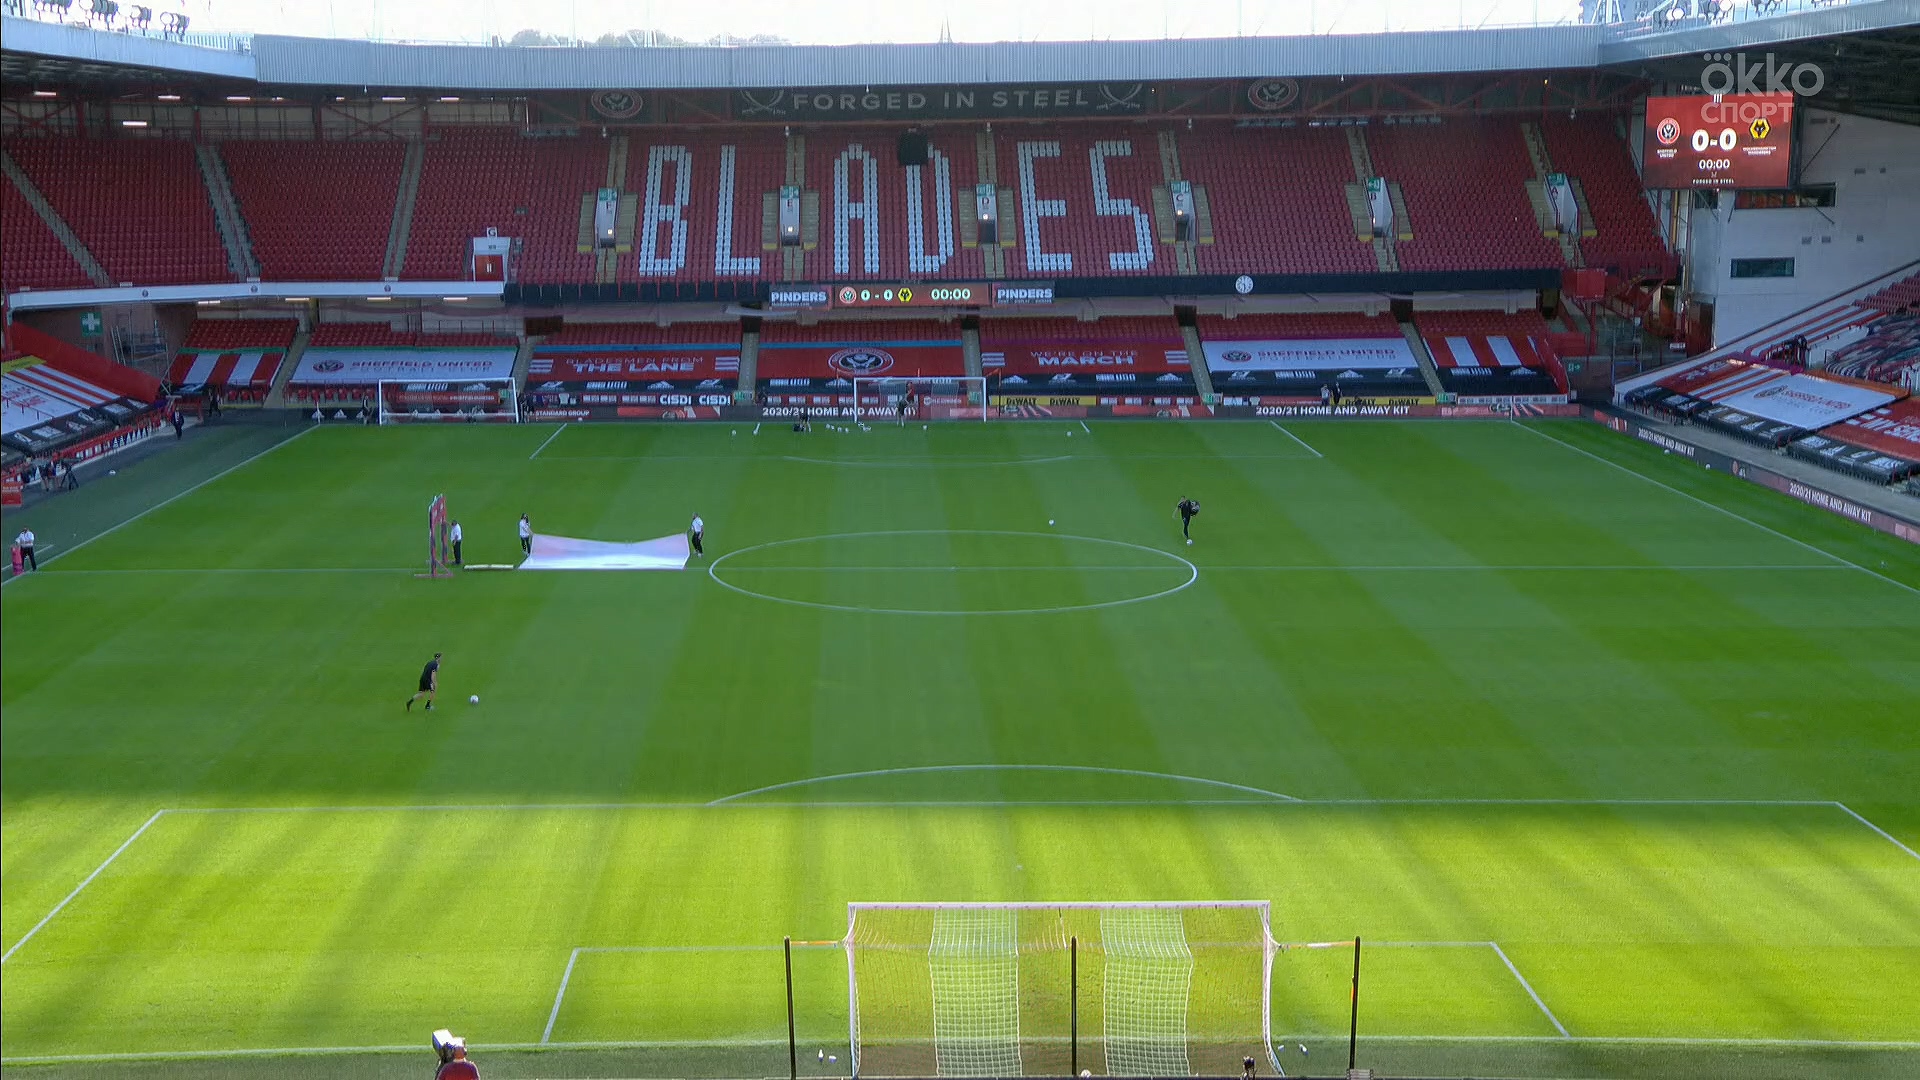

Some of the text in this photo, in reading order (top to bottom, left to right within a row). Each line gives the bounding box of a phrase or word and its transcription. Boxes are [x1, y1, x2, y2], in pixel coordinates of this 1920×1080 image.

[793, 88, 1089, 111] FORGED IN STEEL
[1699, 159, 1731, 170] 00:00
[638, 141, 1155, 276] BLADES
[771, 291, 827, 302] PINDERS
[931, 288, 971, 301] 00:00
[997, 288, 1053, 299] PINDERS
[1038, 355, 1133, 366] MARCH
[573, 363, 694, 373] THE LANE
[660, 394, 692, 405] CISDI
[699, 394, 731, 405] CISDI
[535, 409, 567, 417] STANDARD
[568, 409, 590, 417] GROUP
[807, 406, 839, 417] HOME
[842, 406, 865, 417] AND
[868, 406, 898, 417] AWAY
[1256, 405, 1410, 416] 2020/21 HOME AND AWAY KIT
[1789, 482, 1872, 522] 2020/21 HOME AND AWAY KIT
